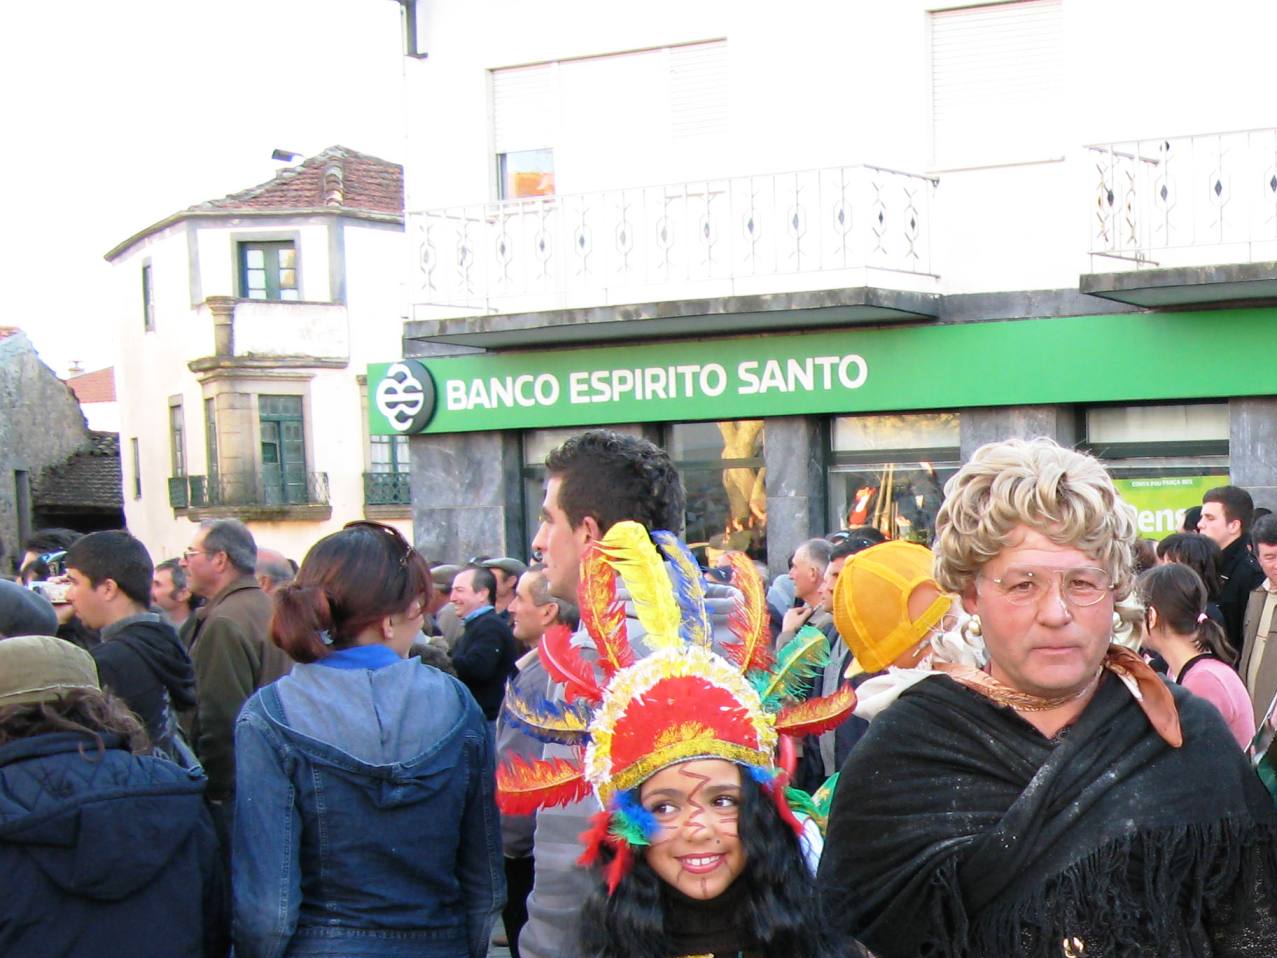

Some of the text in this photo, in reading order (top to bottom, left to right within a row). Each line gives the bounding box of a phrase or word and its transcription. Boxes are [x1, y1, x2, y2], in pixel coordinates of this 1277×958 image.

[446, 354, 868, 411] BANCO ESPIRITO SANTO
